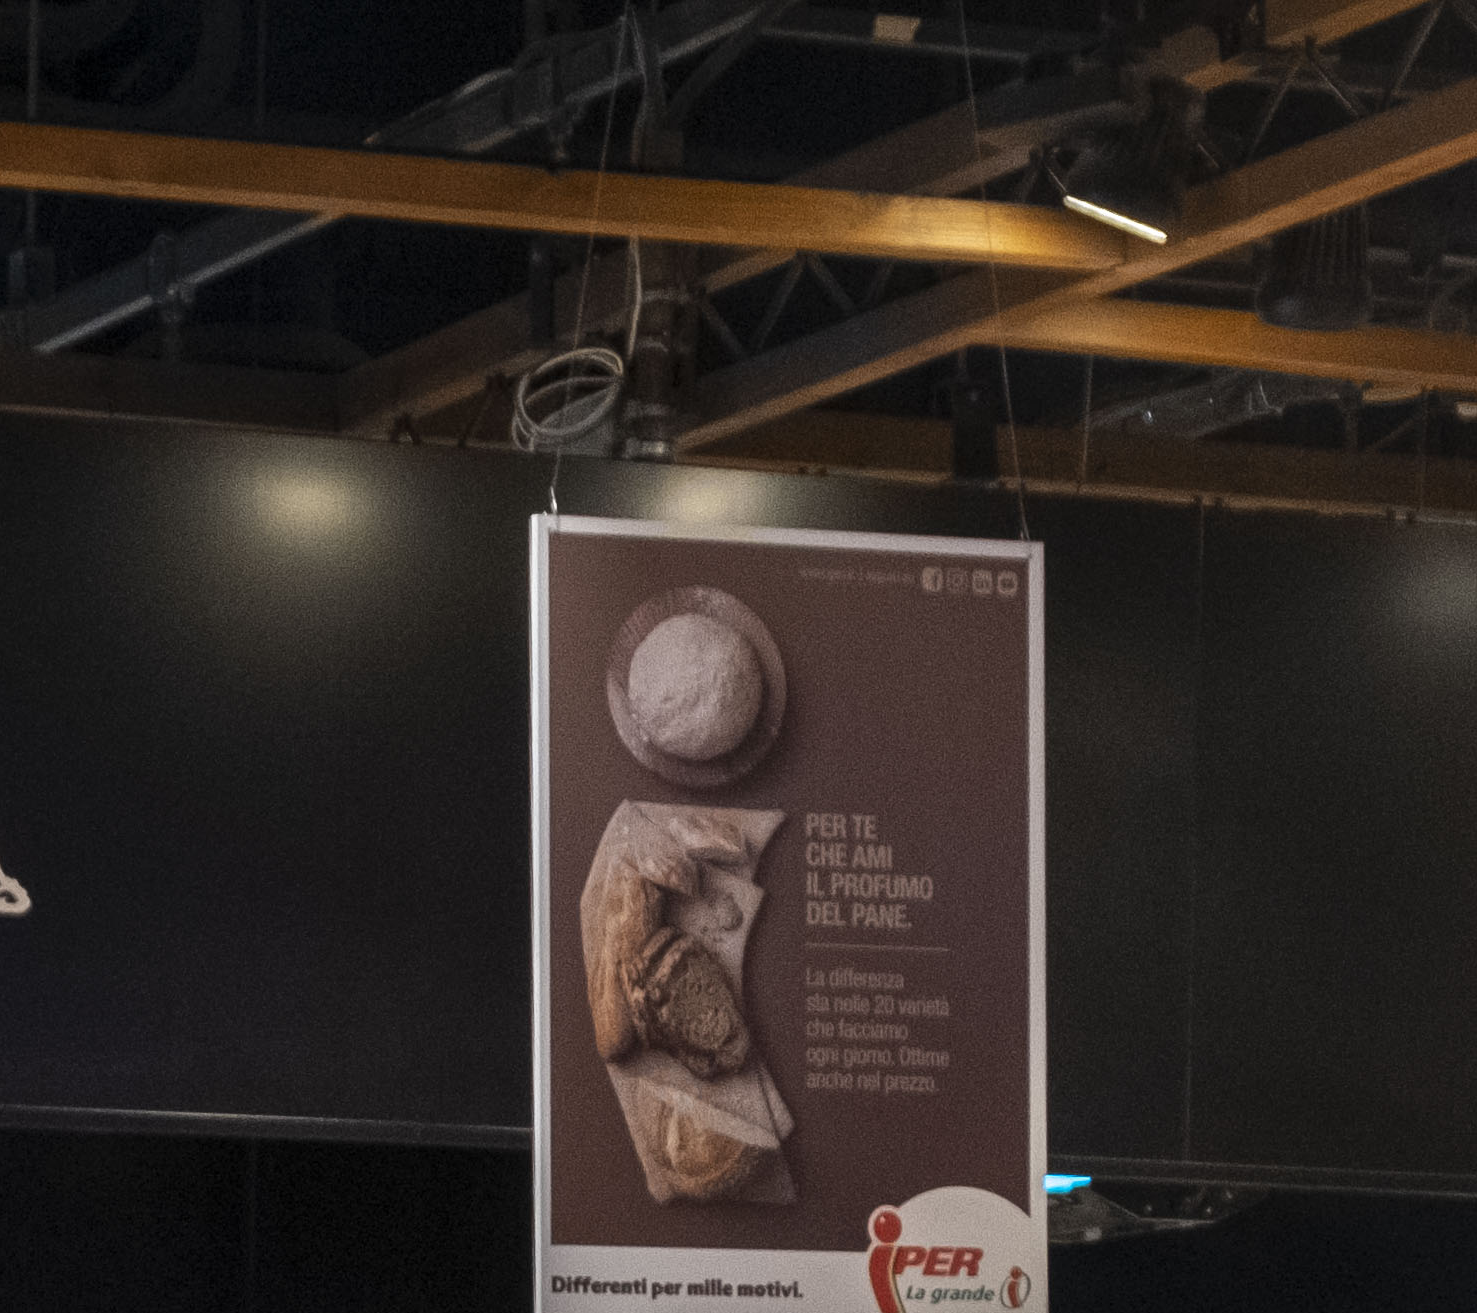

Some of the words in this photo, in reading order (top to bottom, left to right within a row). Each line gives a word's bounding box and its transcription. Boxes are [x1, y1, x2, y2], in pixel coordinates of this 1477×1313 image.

[805, 812, 847, 838] PER
[851, 814, 878, 840] TE
[805, 842, 847, 867] CHE
[851, 844, 894, 869] AMI
[805, 871, 825, 898] IL
[830, 872, 934, 900] PROFUMO
[805, 901, 847, 926] DEL
[851, 903, 913, 928] PANE.
[806, 967, 826, 987] La
[829, 967, 905, 989] differenza
[806, 1019, 835, 1038] che
[837, 1019, 909, 1040] facciamo
[806, 1047, 840, 1067] ogni
[806, 1072, 854, 1090] anche
[857, 1071, 881, 1091] nel
[551, 1275, 648, 1297] Differenti
[650, 1280, 683, 1303] per
[687, 1279, 734, 1299] mille
[737, 1280, 805, 1301] motivi.
[906, 1284, 927, 1302] La
[930, 1284, 996, 1307] grande
